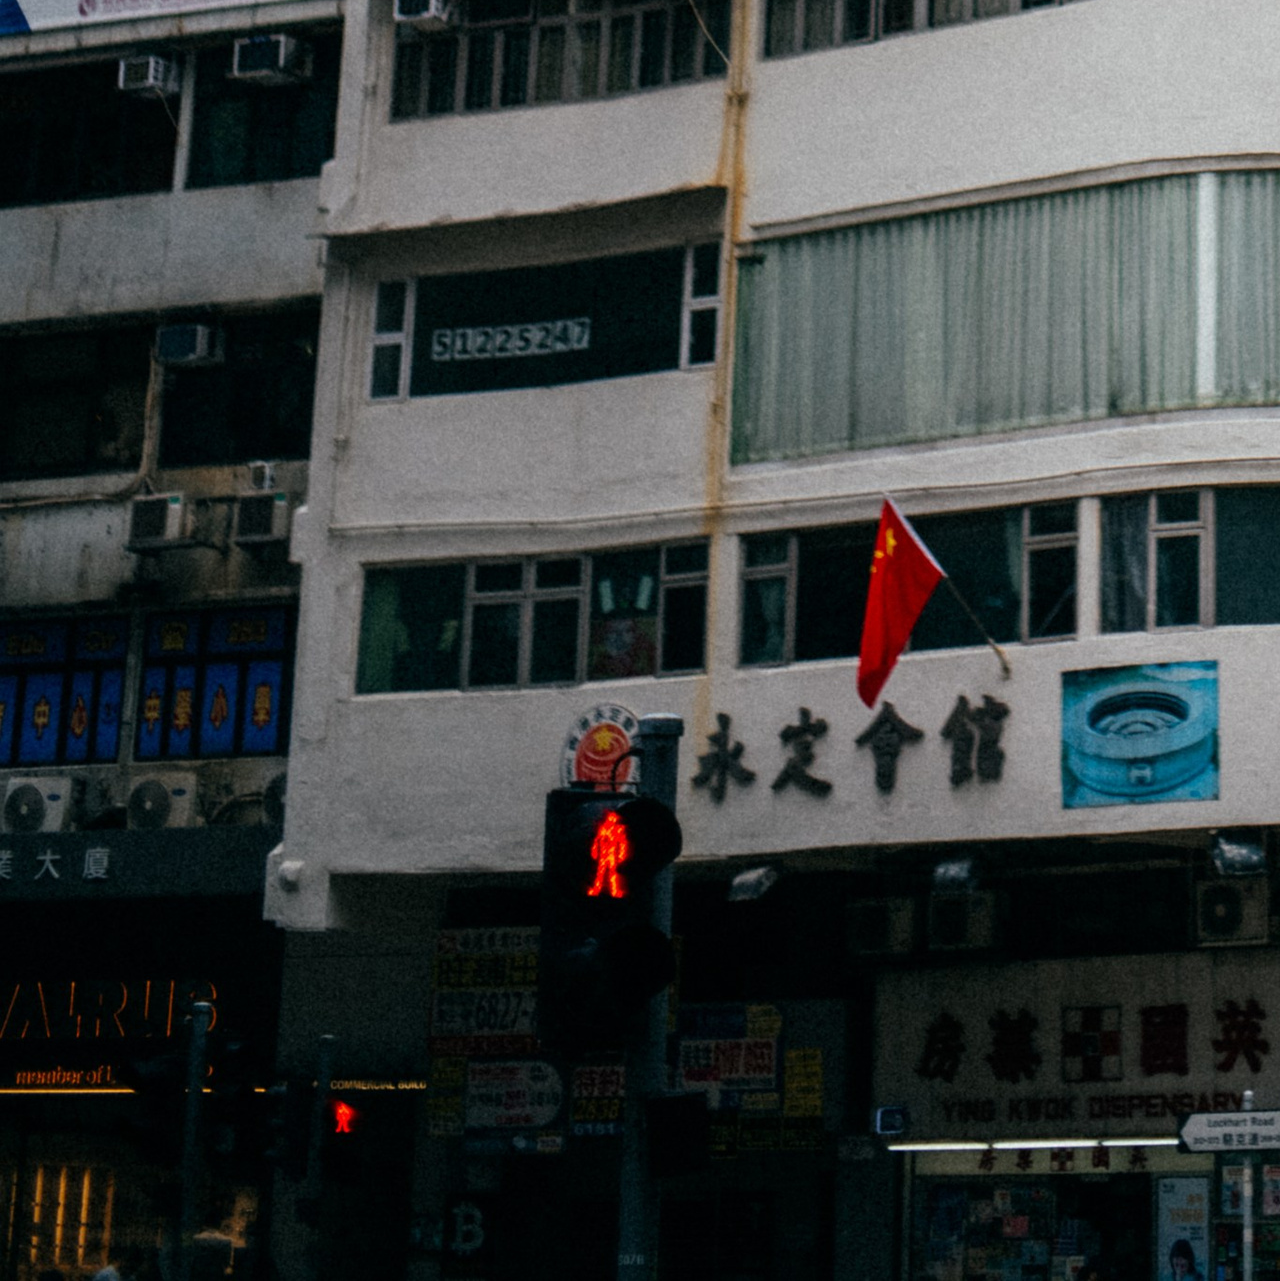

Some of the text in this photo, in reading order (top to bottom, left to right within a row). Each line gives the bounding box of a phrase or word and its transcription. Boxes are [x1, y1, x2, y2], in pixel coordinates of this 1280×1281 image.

[691, 693, 1010, 803] 永定會館
[330, 1079, 394, 1090] COMMERCIAL
[941, 1091, 1245, 1123] YING KWOK DISPENSARY
[1206, 1116, 1275, 1128] Lockhart Road
